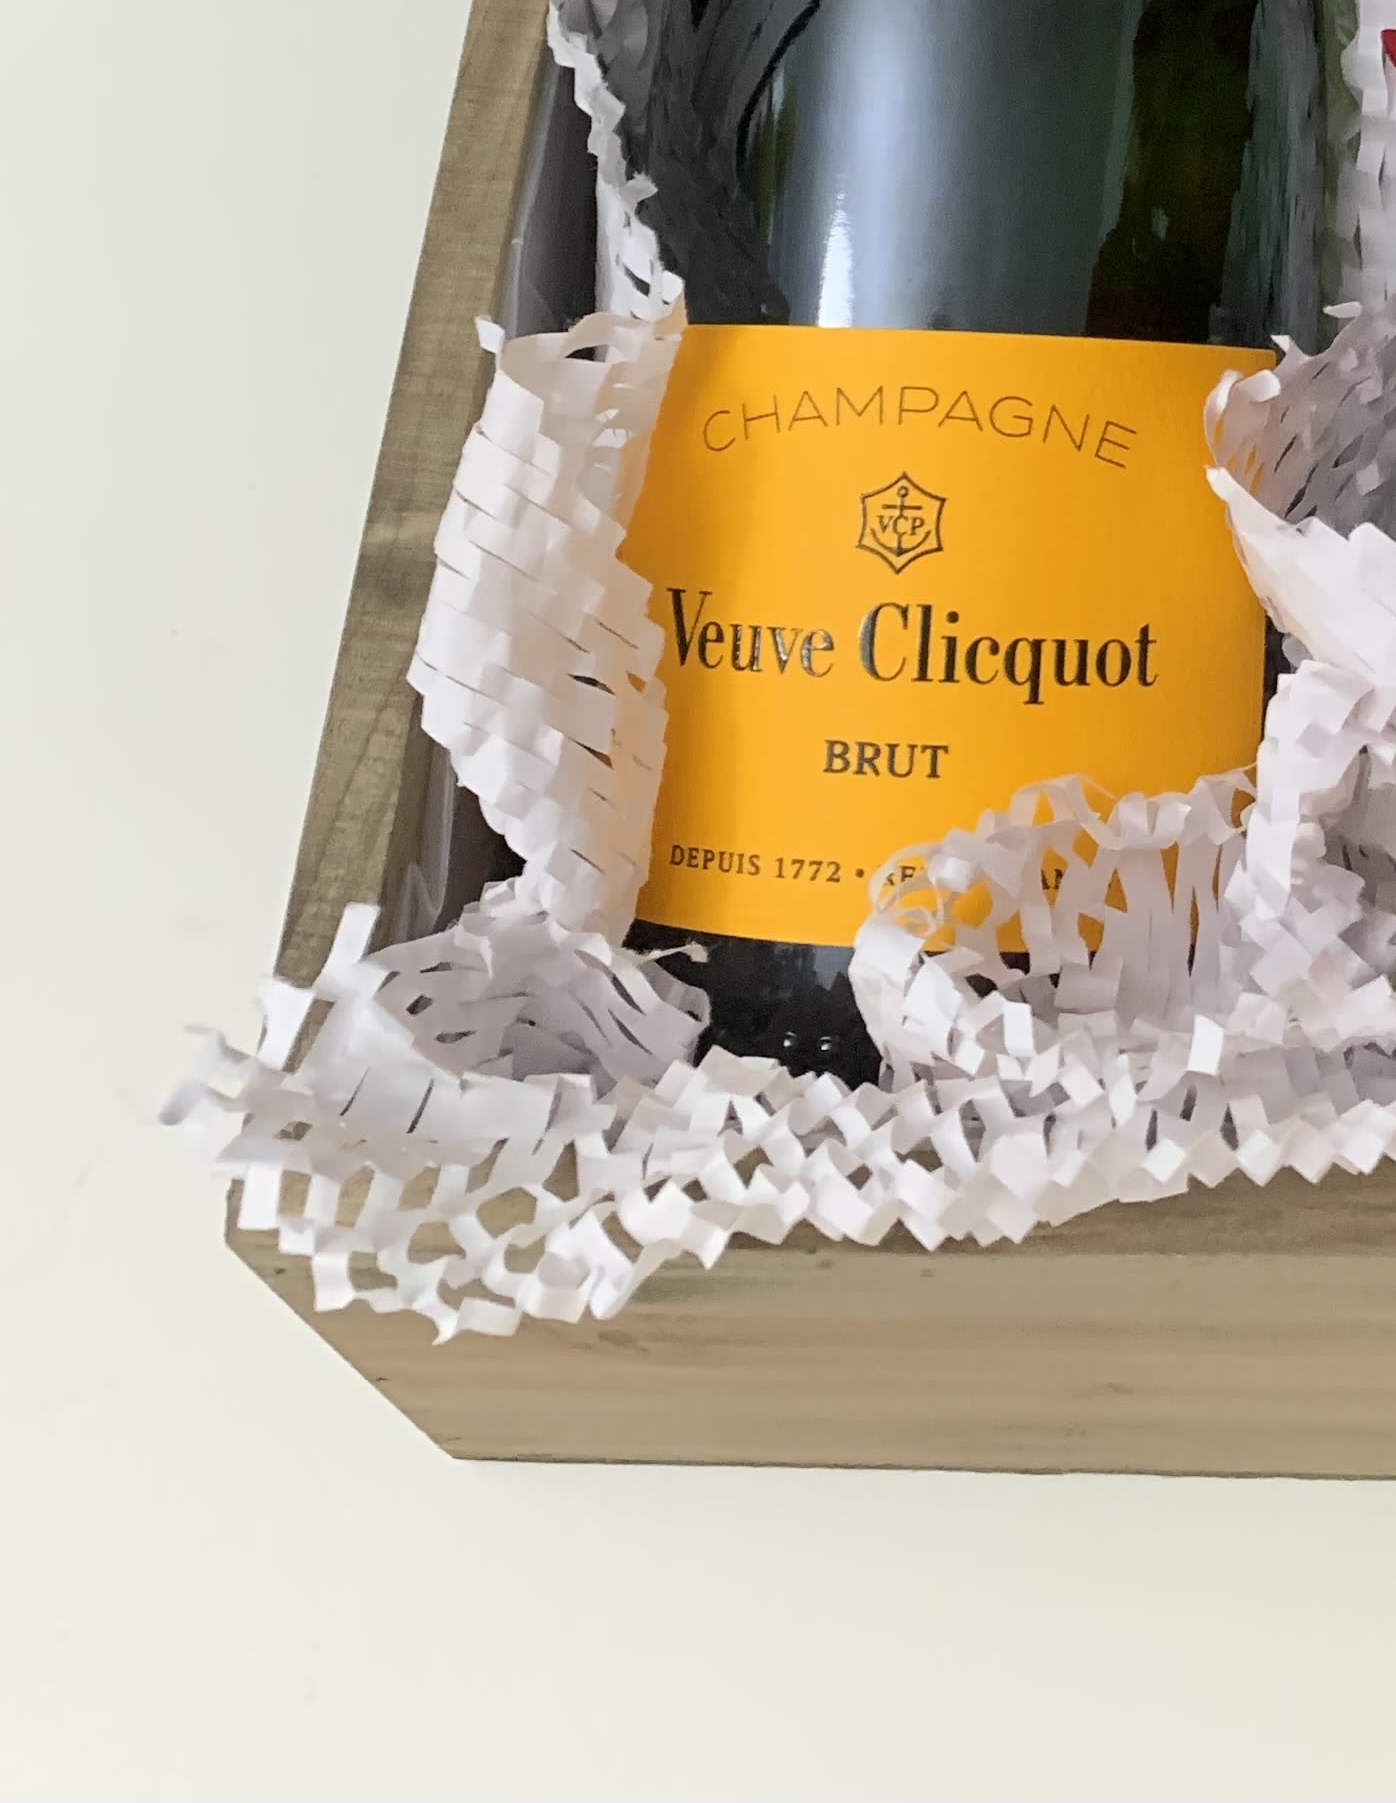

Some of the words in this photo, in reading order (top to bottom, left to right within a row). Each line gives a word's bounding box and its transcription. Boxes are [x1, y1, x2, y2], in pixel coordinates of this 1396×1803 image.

[703, 385, 1137, 469] CHAMPAGNE
[876, 514, 925, 536] VCP
[666, 587, 836, 677] Veuve
[858, 601, 1159, 705] Clicquot
[823, 739, 949, 779] BRUT
[670, 844, 761, 876] DEPUIS
[775, 857, 841, 883] 1772
